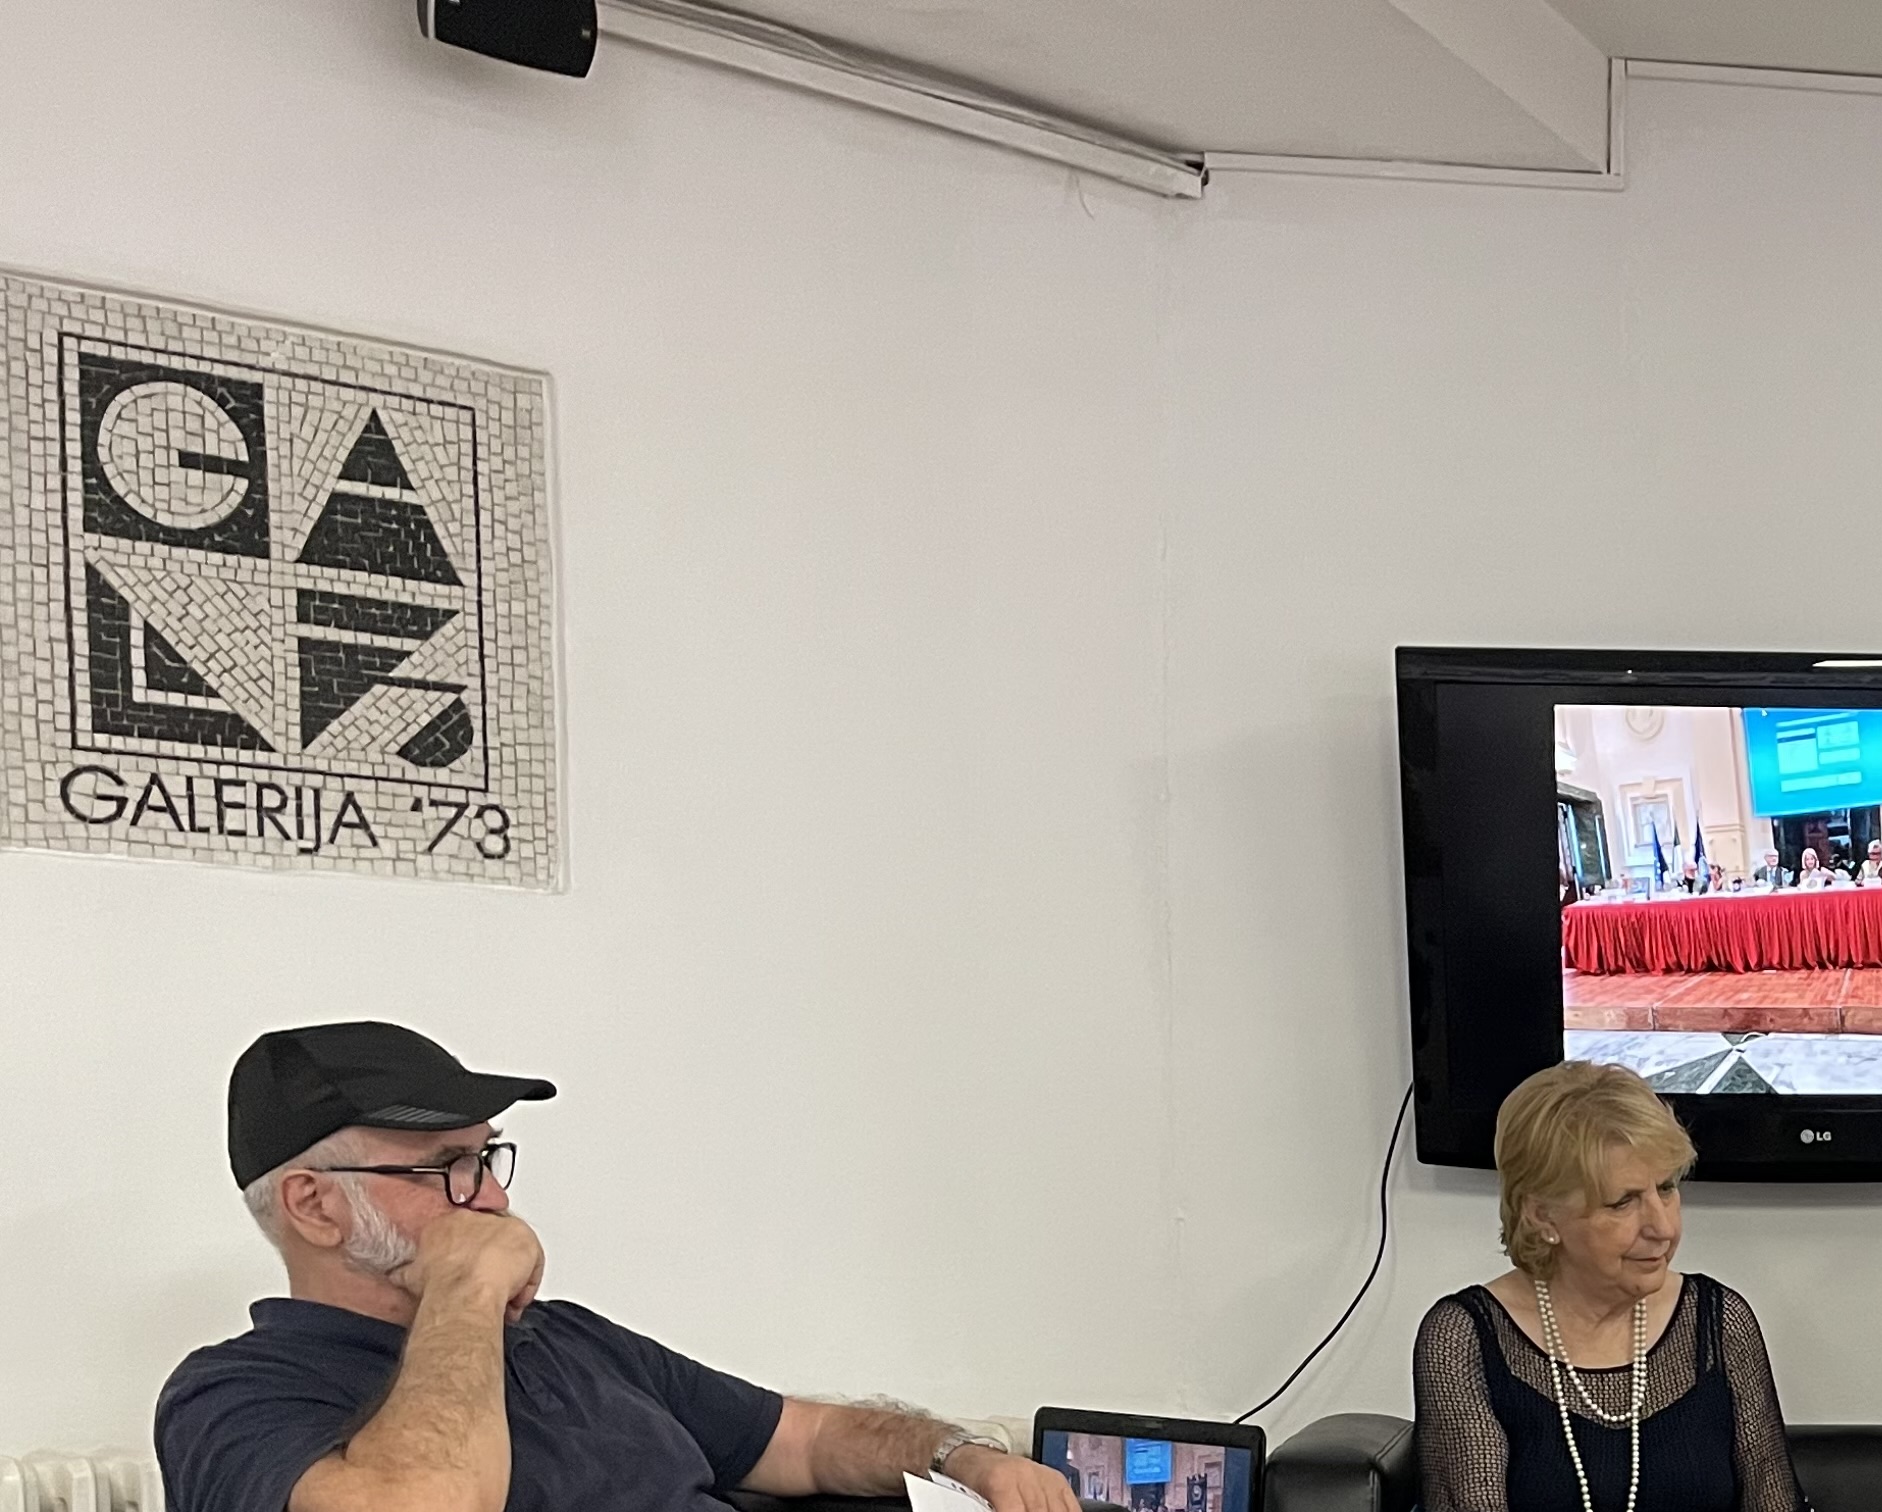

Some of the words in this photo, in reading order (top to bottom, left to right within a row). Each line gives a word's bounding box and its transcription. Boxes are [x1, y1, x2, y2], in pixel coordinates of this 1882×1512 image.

[60, 764, 379, 854] GALERIJA
[410, 797, 510, 860] '73
[1816, 1131, 1832, 1141] LG
